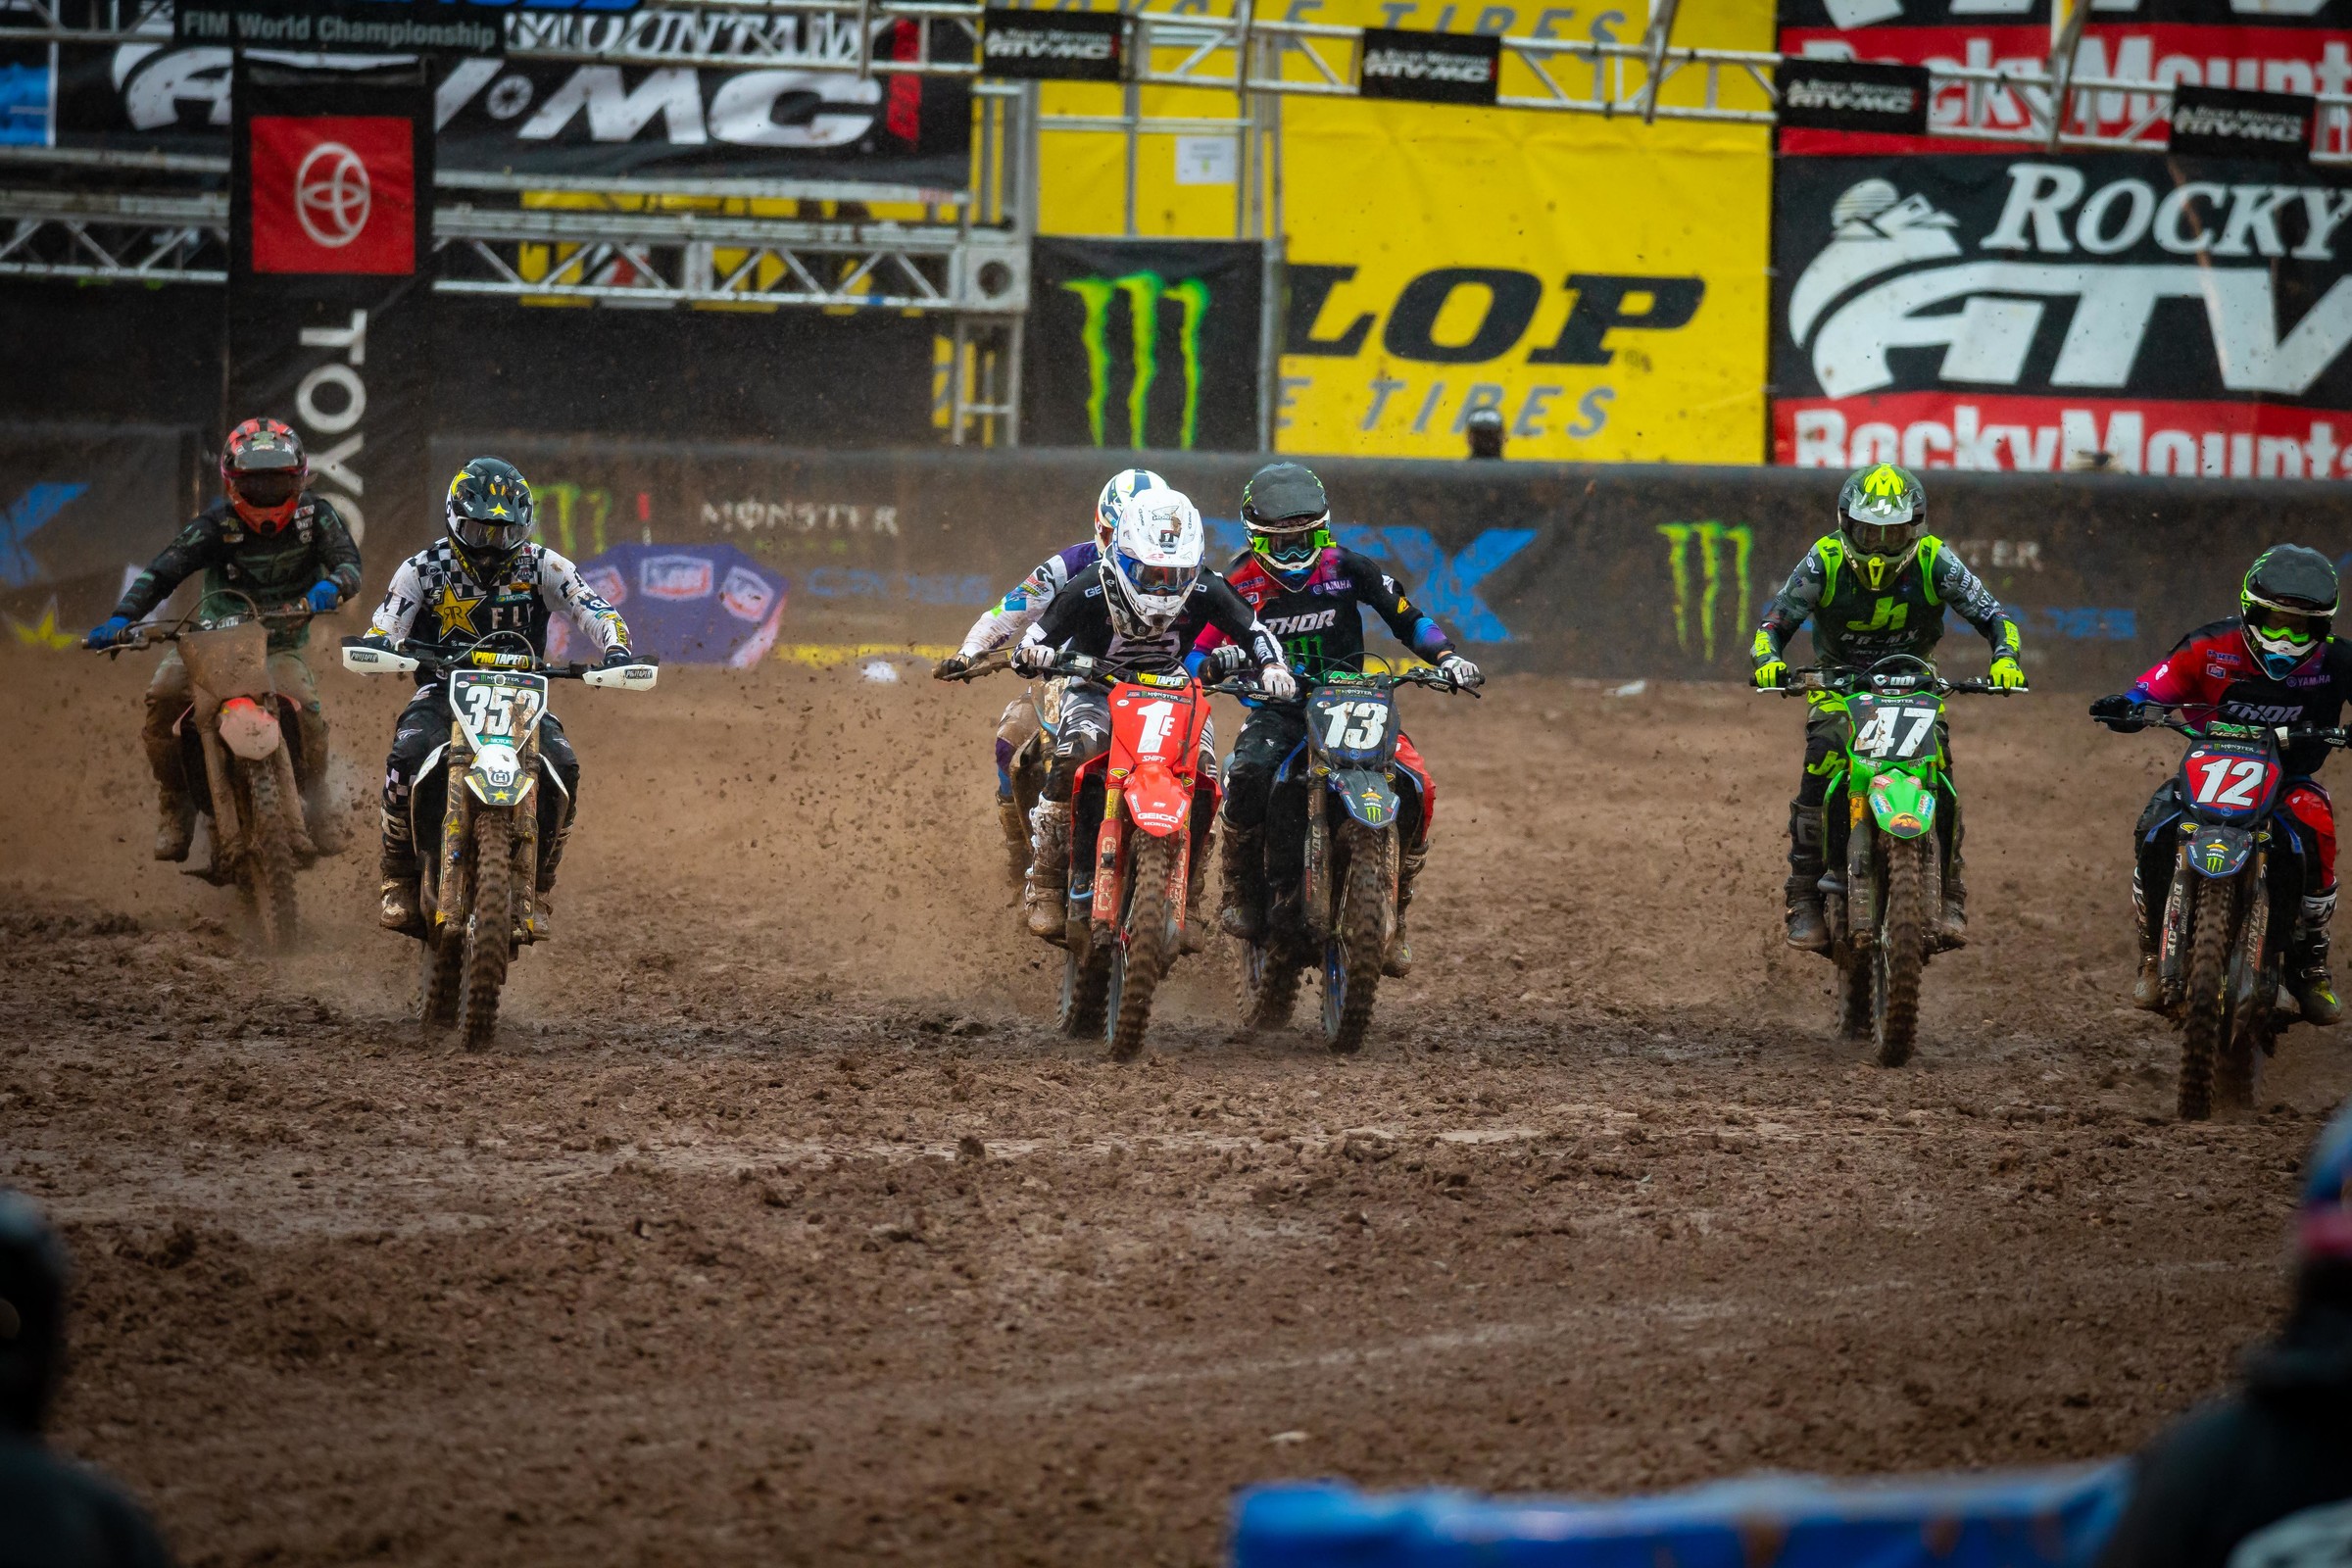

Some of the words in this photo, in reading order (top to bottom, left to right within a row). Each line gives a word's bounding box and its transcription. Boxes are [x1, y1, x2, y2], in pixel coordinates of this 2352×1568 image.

[183, 10, 229, 36] FIM
[236, 13, 312, 41] World
[318, 16, 497, 49] Championship
[1981, 162, 2352, 260] ROCKY
[1362, 379, 1616, 439] TIRES
[1264, 609, 1337, 635] THOR
[1140, 672, 1182, 686] PROTAPER
[2298, 674, 2331, 686] YAMAHA
[465, 685, 540, 737] 352
[1324, 701, 1388, 750] 13
[2227, 700, 2304, 723] THOR
[1853, 707, 1936, 759] 47
[1142, 755, 1166, 763] SHIFT
[2196, 759, 2267, 807] 12
[1138, 812, 1179, 823] GEICO
